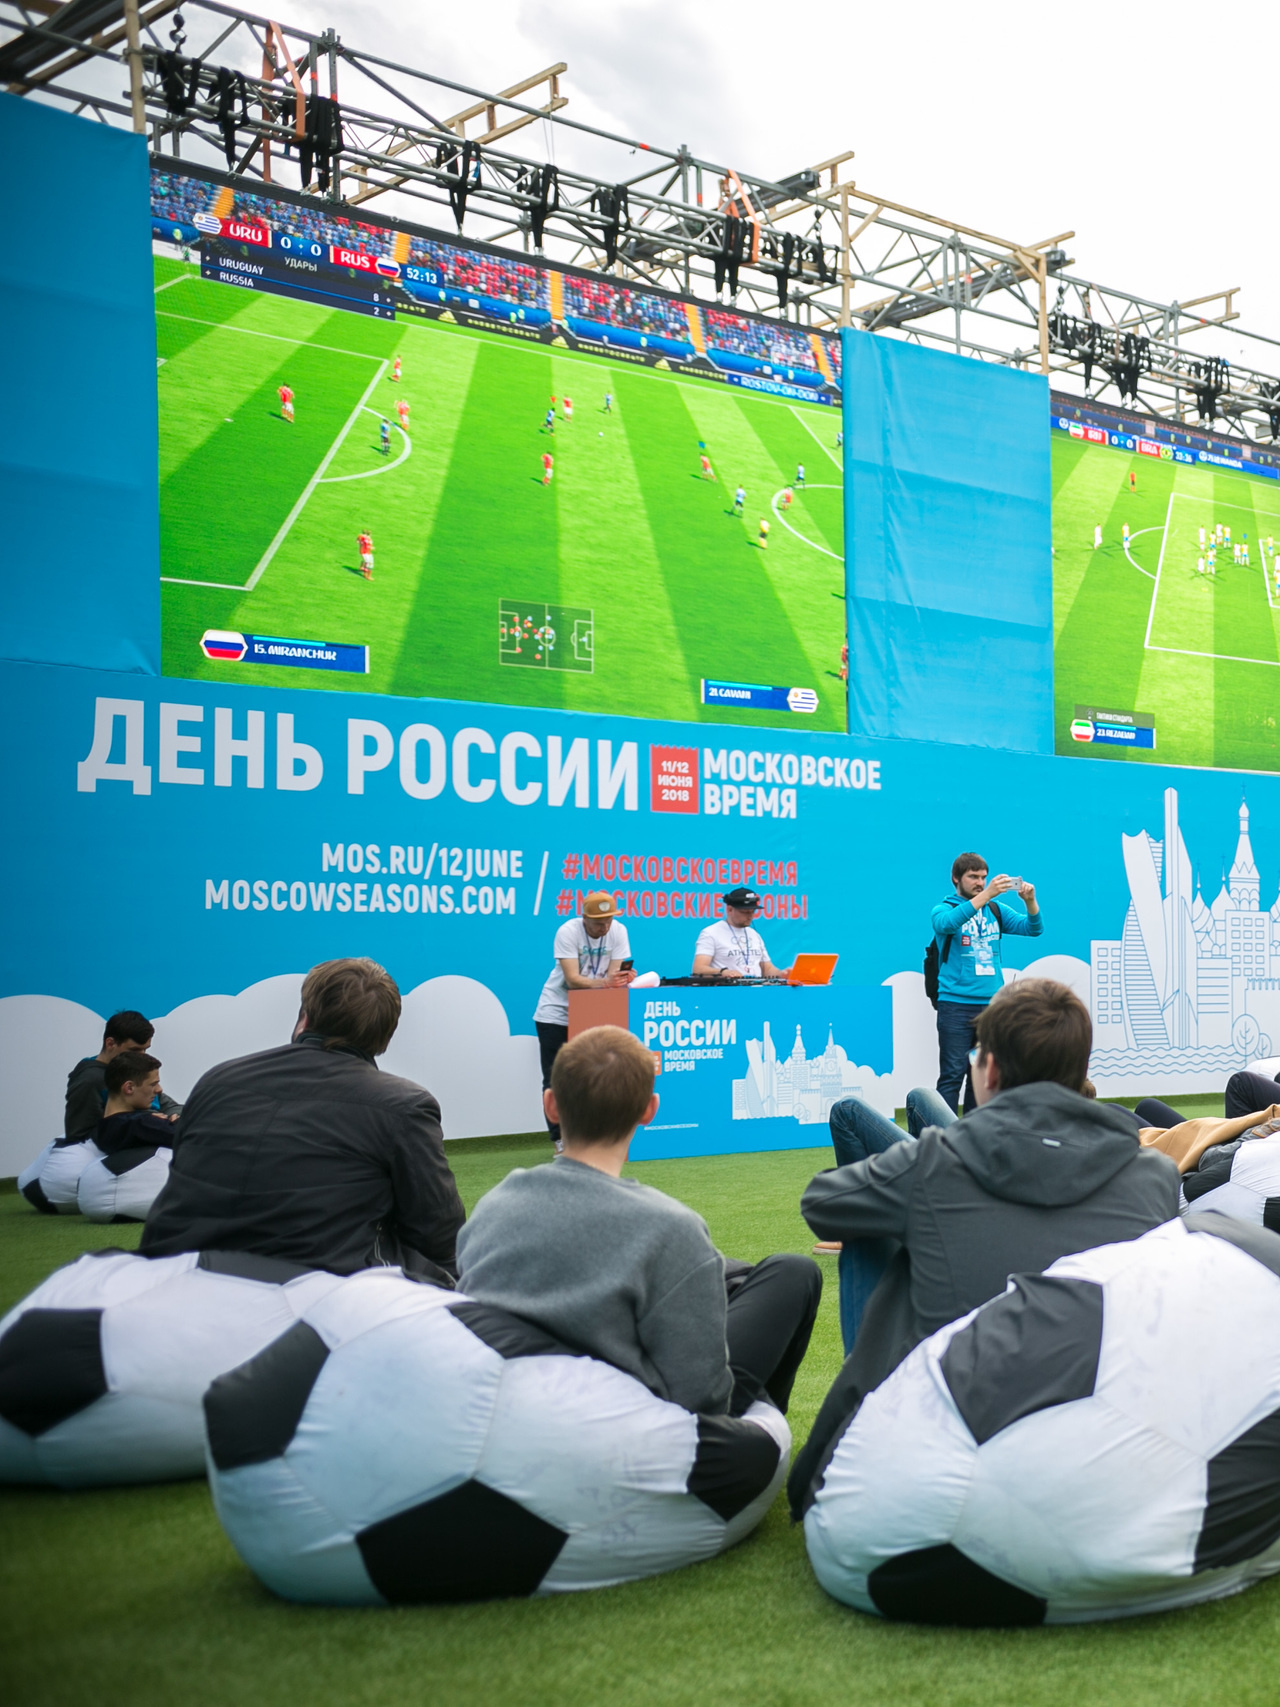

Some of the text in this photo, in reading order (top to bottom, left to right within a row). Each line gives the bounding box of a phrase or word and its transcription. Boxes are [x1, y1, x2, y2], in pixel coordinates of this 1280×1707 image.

[229, 223, 371, 268] URU 0 0 RUS
[219, 257, 264, 275] URUGUAY
[284, 257, 318, 272] УДАРЫ
[406, 267, 438, 284] 52:13
[219, 271, 380, 316] RUSSIA 2
[268, 645, 337, 661] MIRANCHUK
[77, 697, 638, 811] ДЕНЬ РОССИИ
[661, 760, 689, 774] 11/12
[703, 748, 882, 790] МОСКОВСКОЕ
[658, 774, 693, 788] ИЮНЯ
[661, 788, 690, 802] 2018
[703, 783, 797, 819] ВРЕМЯ
[322, 842, 523, 882] MOS.RU/12JUNE
[562, 853, 798, 887] #МОСКОВСКОЕВРЕМЯ
[205, 879, 516, 915] MOSCOWSEASONS.COM
[555, 889, 809, 920] #СКОВСКИЕОНЫ
[644, 1001, 681, 1019] ДЕНЬ
[644, 1019, 737, 1048] РОССИИ
[664, 1048, 724, 1061] МОСКОВСКОЕ
[664, 1060, 695, 1072] ВРЕМЯ
